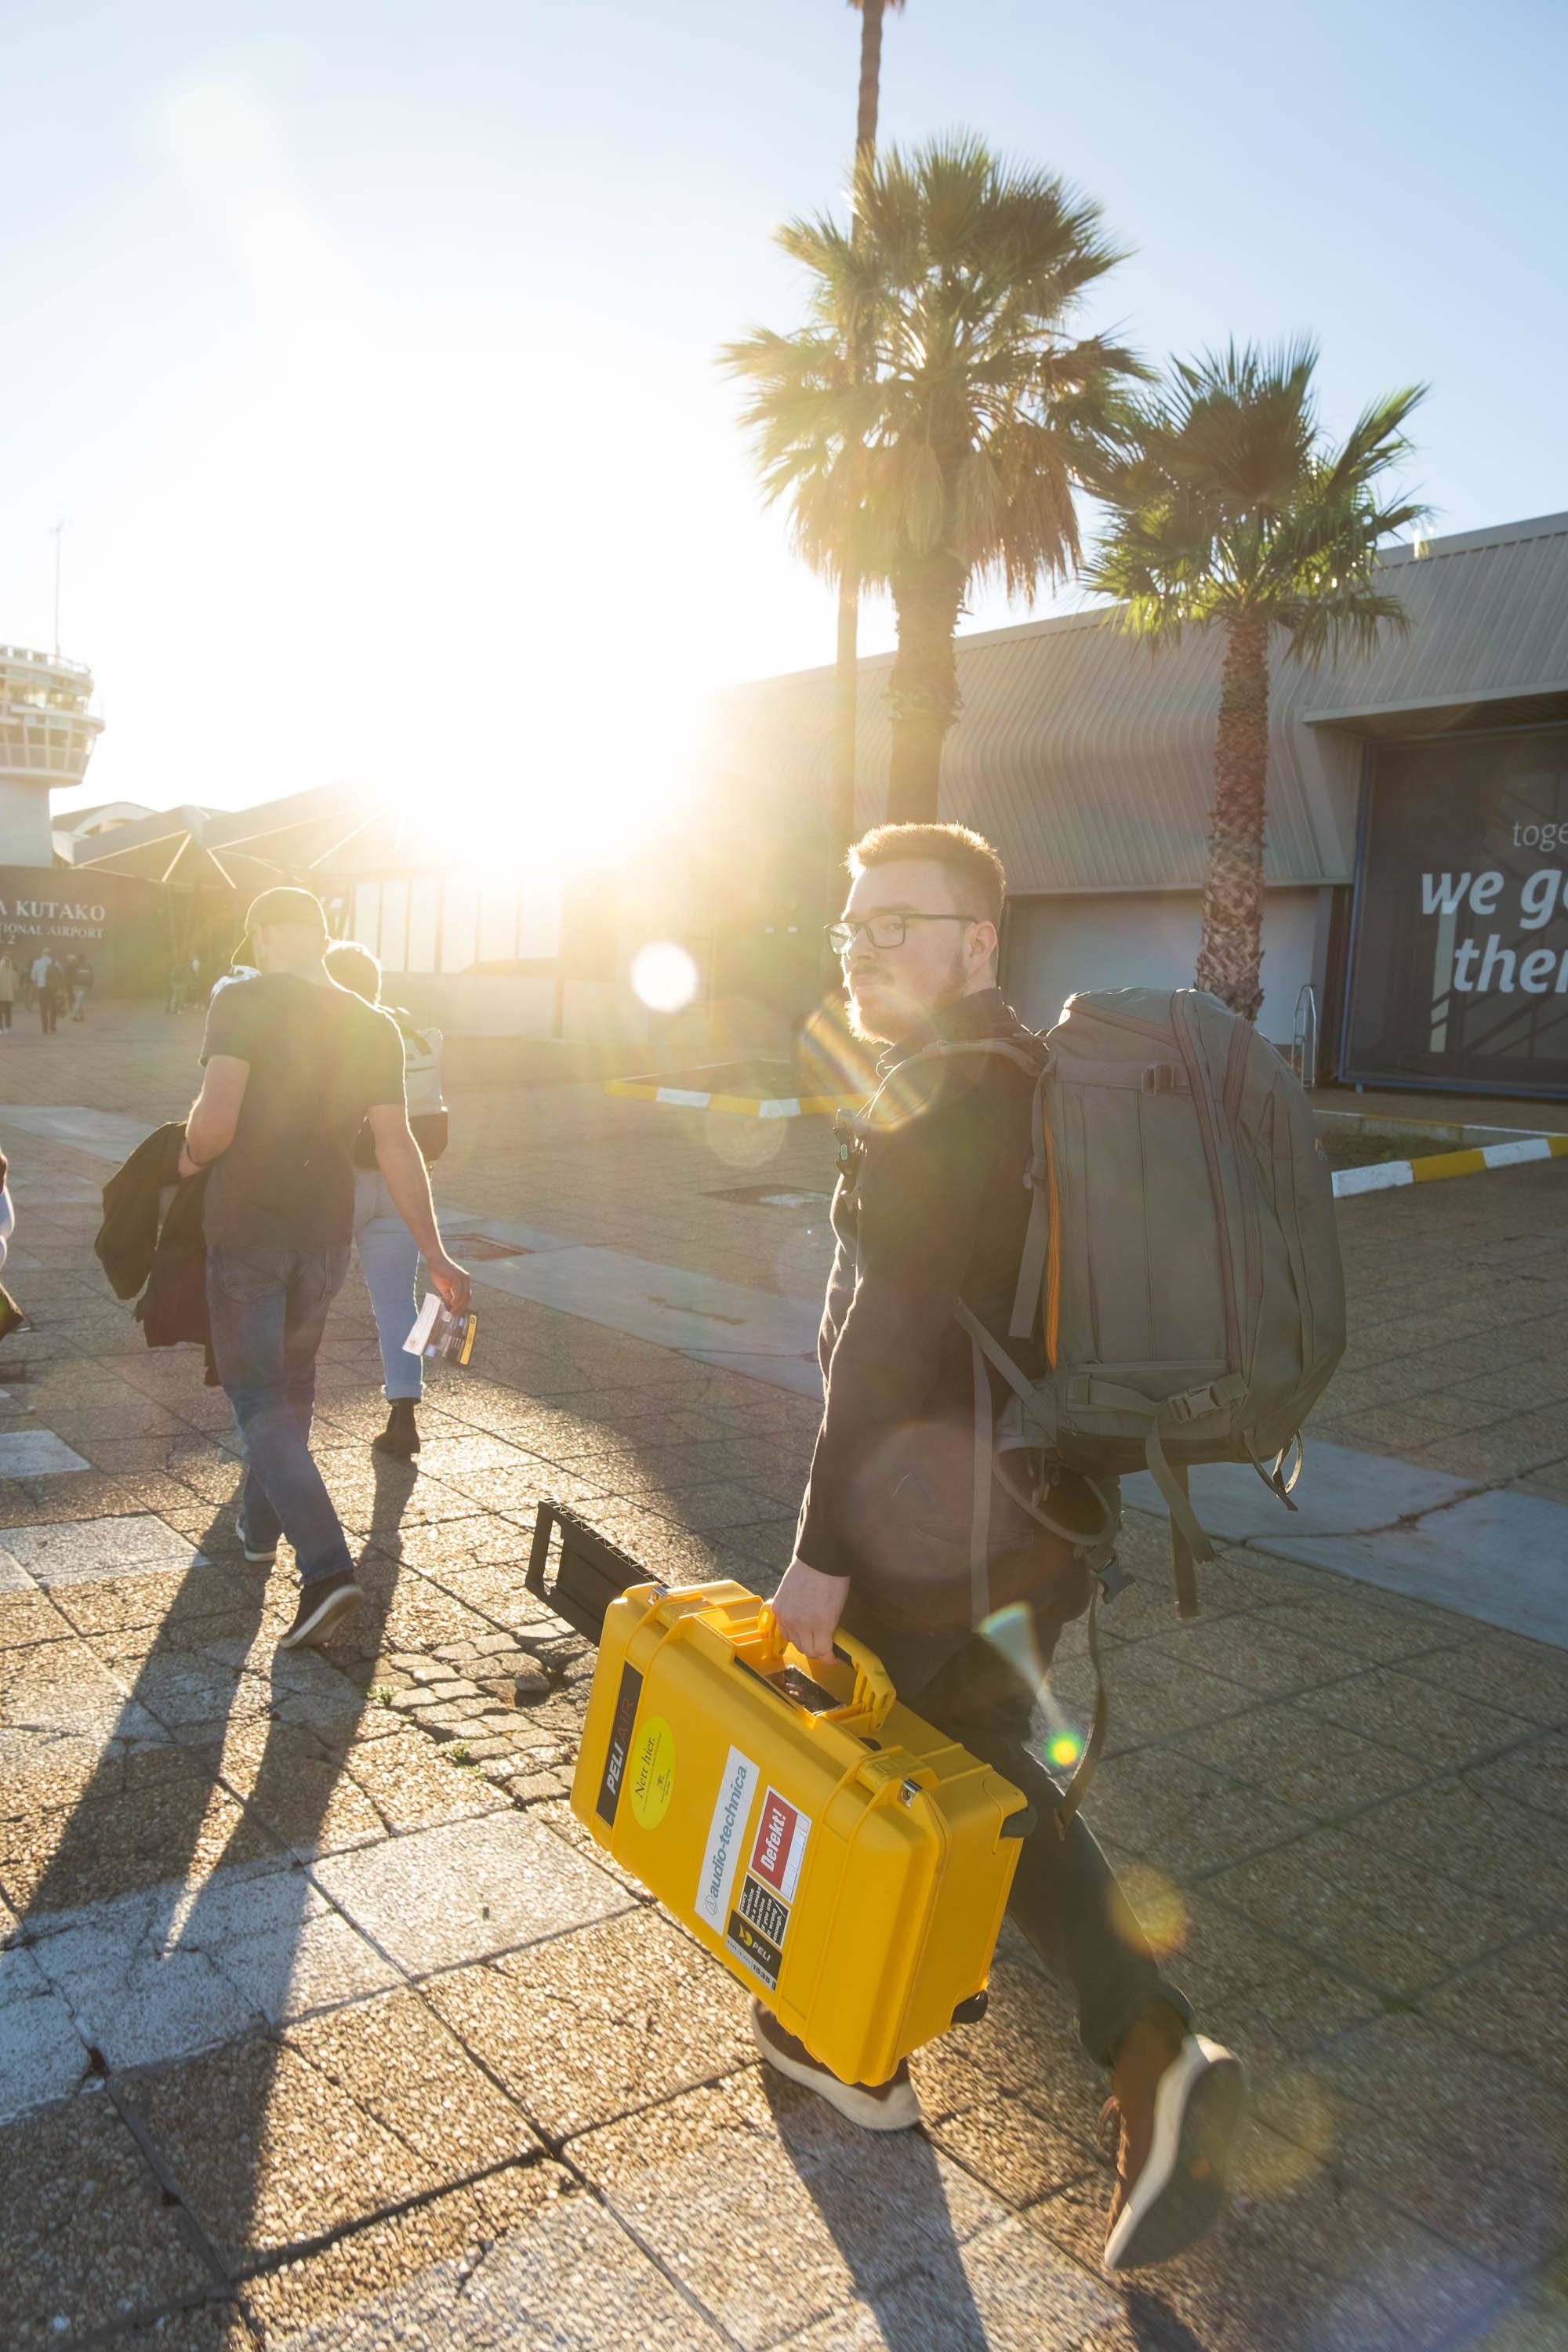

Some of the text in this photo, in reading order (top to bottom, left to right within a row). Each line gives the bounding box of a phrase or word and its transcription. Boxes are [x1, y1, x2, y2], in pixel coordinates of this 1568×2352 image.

[15, 899, 106, 922] KUTAKO
[1421, 869, 1568, 930] we g
[48, 925, 103, 939] AIRPORT
[606, 1697, 634, 1795] PELI AIR
[641, 1737, 656, 1766] hier.
[634, 1766, 649, 1798] Nett
[710, 1765, 747, 1898] audio-technica
[760, 1806, 786, 1873] Defekt!
[745, 1888, 754, 1916] machine
[753, 1886, 762, 1908] smoke
[756, 1897, 766, 1926] machine
[768, 1907, 778, 1929] wrong
[752, 1940, 771, 1962] PELI
